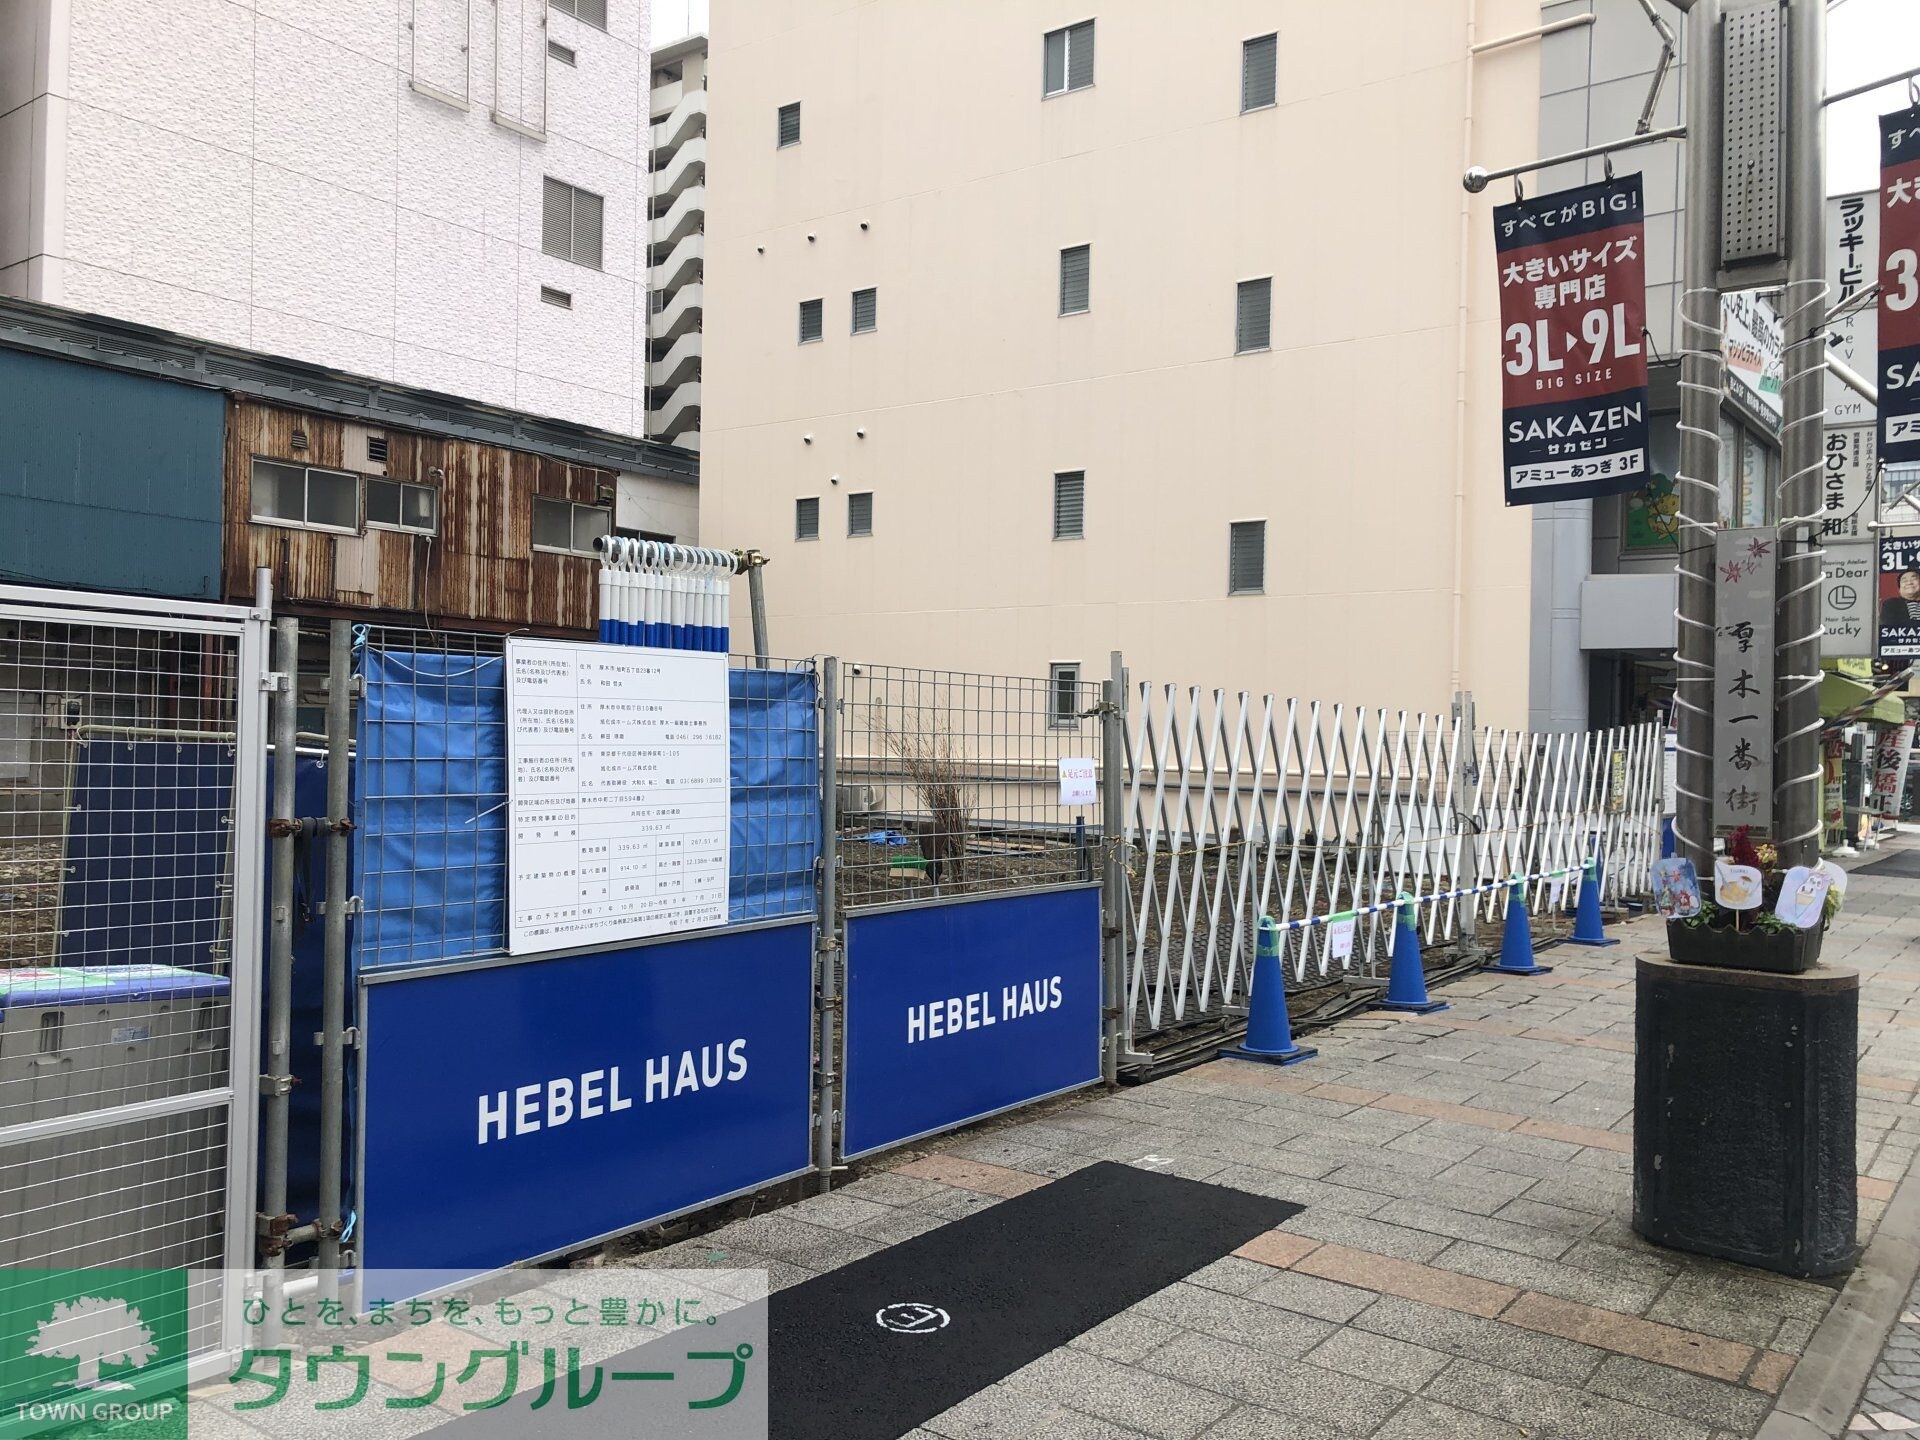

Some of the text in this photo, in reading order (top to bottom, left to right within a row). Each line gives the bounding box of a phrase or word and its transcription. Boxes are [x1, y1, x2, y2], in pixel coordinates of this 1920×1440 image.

[1500, 190, 1638, 238] すべてがBIG!
[1503, 235, 1638, 289] 大きいサイズ
[1838, 197, 1864, 304] ラッキービル
[1534, 274, 1606, 310] 専門店
[1505, 302, 1641, 377] 3L 9L
[1536, 367, 1613, 390] BIG SIZE
[1509, 401, 1642, 444] SAKAZEN
[1834, 403, 1861, 416] GYM
[1548, 437, 1607, 456] サカゼン
[1516, 454, 1639, 483] アミューあつぎ 3F
[1825, 433, 1848, 511] おひさま
[1836, 567, 1869, 578] Dear
[1881, 551, 1908, 571] 3L
[1720, 620, 1761, 816] 厚木一番街
[517, 814, 576, 822] 特定開発事業の目的
[907, 975, 1063, 1044] HEBEL HAUS
[477, 1038, 748, 1145] HEBEL HAUS
